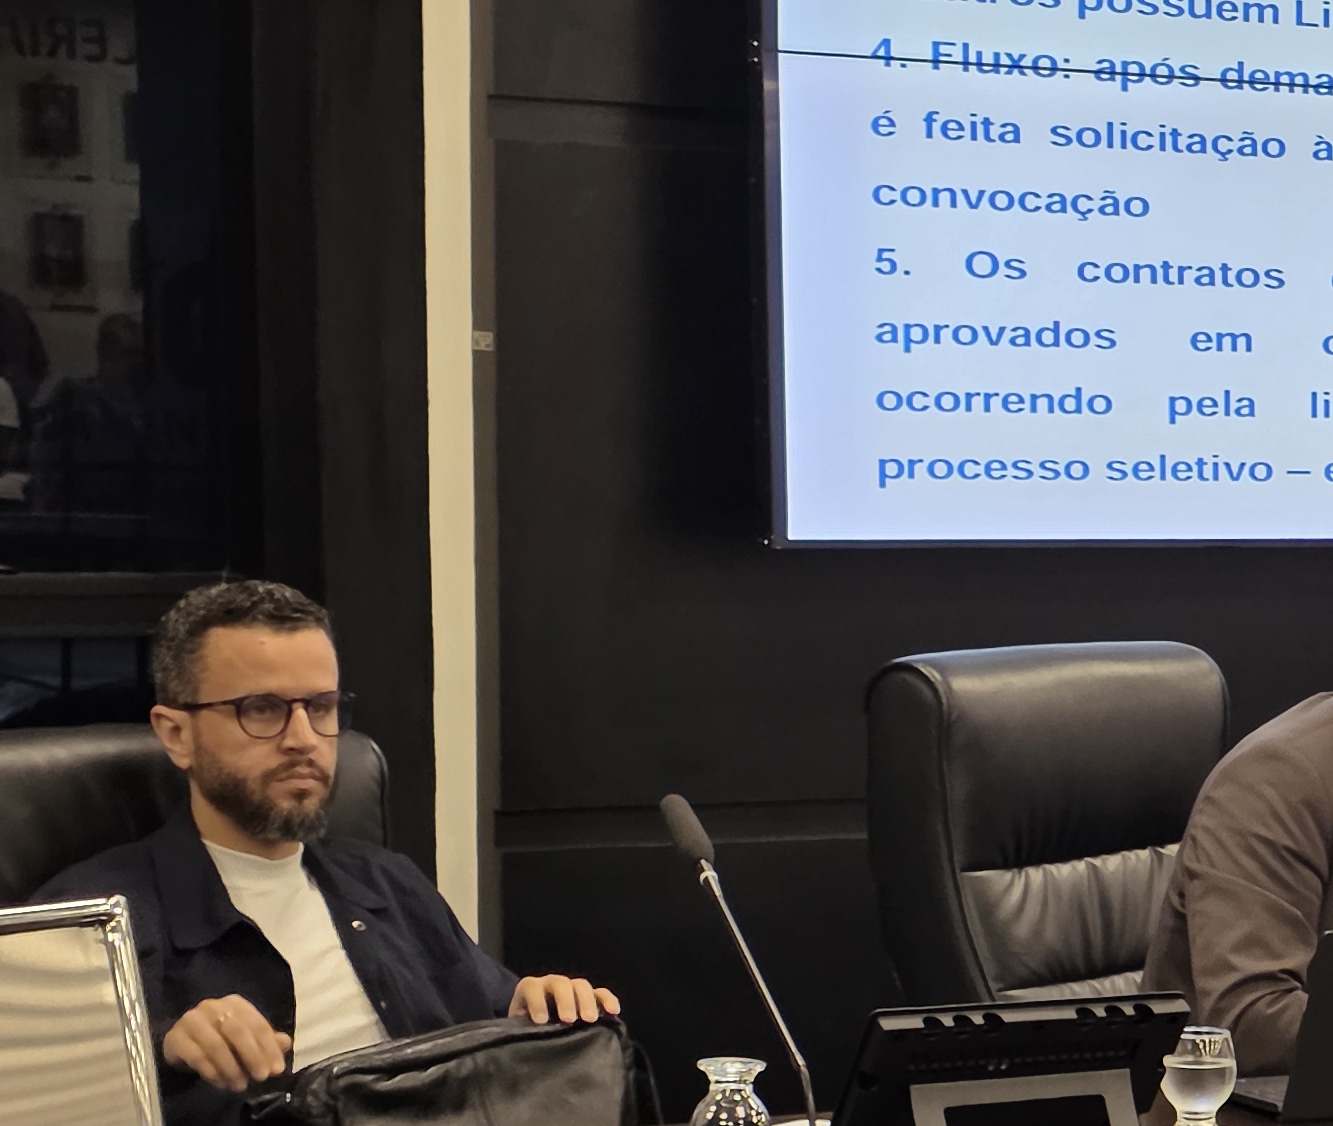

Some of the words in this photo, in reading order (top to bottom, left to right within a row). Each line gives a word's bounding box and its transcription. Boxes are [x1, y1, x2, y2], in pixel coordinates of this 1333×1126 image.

[869, 38, 909, 69] 4.
[930, 41, 1072, 79] Fluxo:
[1093, 57, 1203, 93] após
[870, 110, 897, 137] é
[922, 109, 1021, 145] feita
[1050, 119, 1286, 162] solicitação
[1312, 134, 1333, 161] à
[871, 182, 1150, 222] convocação
[874, 247, 911, 276] 5.
[965, 250, 1027, 280] Os
[1077, 258, 1286, 290] contratos
[874, 320, 1117, 354] aprovados
[1189, 331, 1252, 353] em
[875, 386, 1113, 415] ocorrendo
[1168, 389, 1256, 425] pela
[878, 456, 1090, 489] processo
[1106, 454, 1273, 482] seletivo
